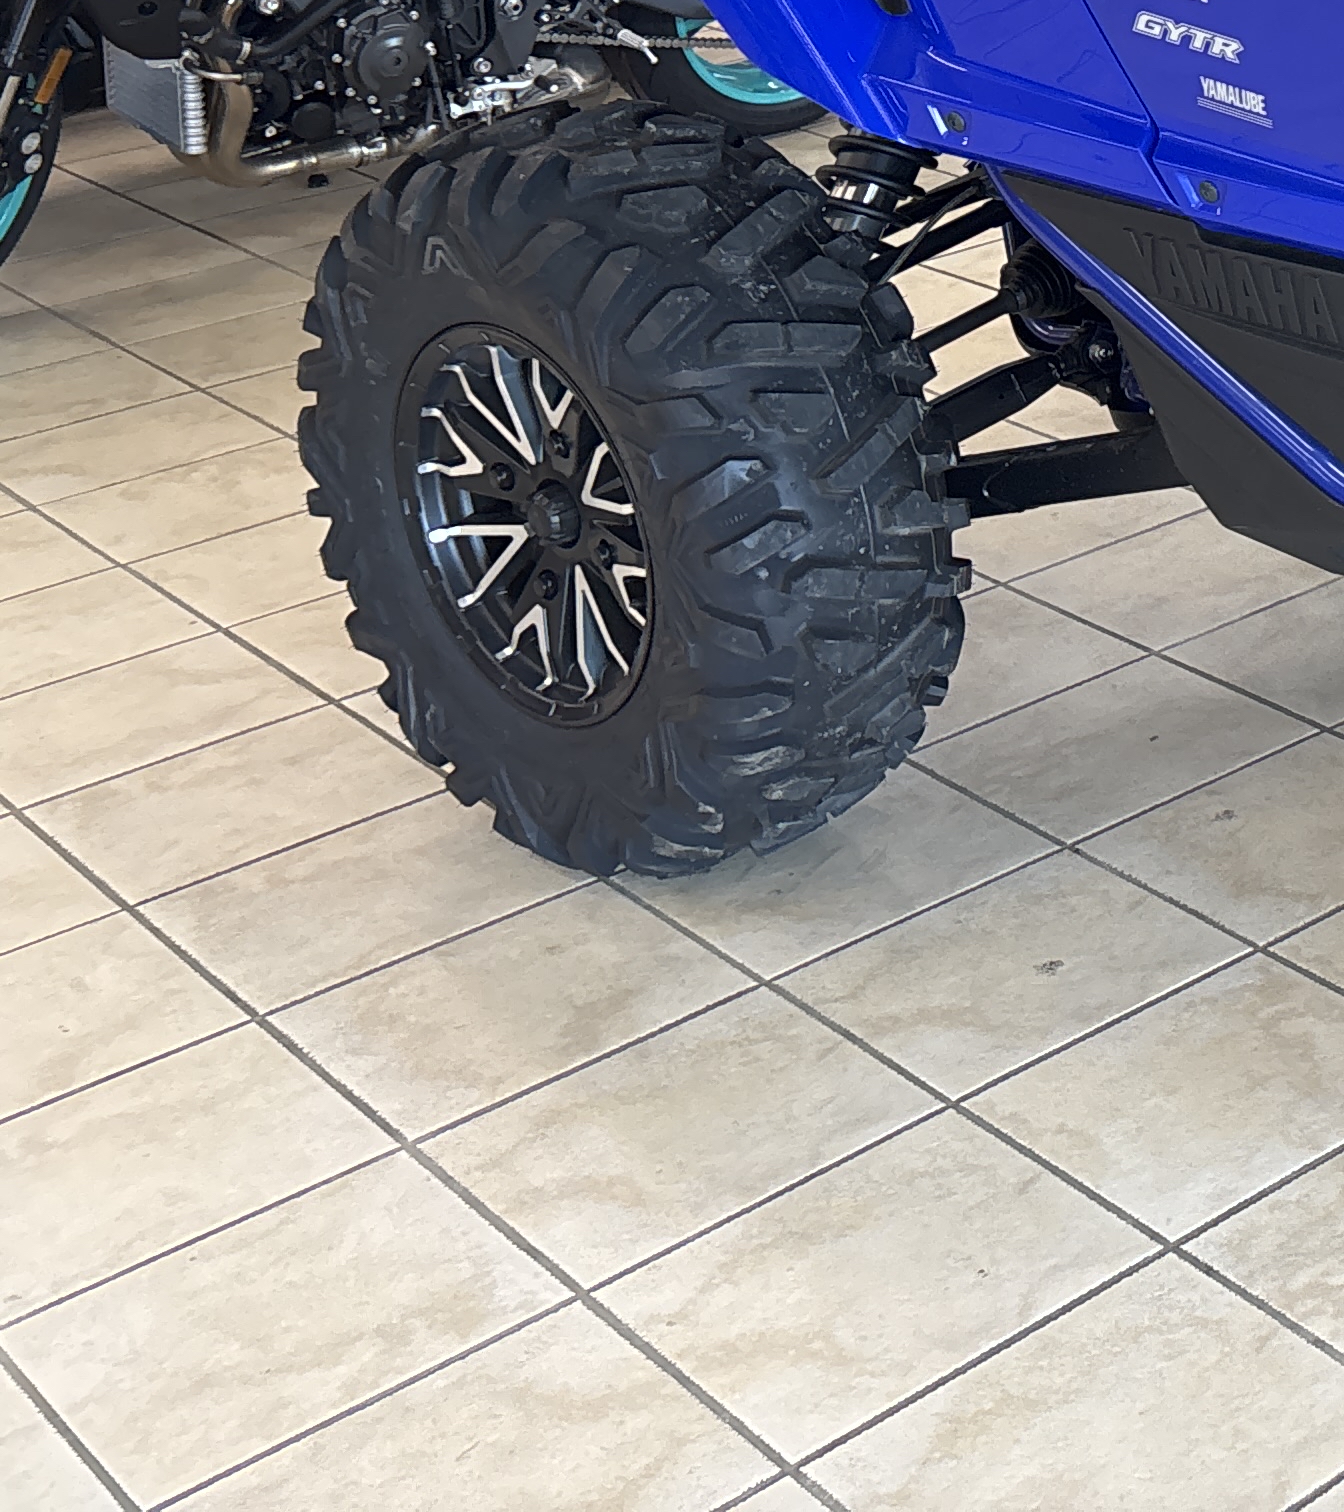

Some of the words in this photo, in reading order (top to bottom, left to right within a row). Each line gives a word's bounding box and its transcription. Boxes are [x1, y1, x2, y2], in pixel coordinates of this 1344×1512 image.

[1132, 10, 1245, 65] GYTR
[1199, 75, 1268, 116] YAMALUBE
[1122, 225, 1338, 345] YAMAHA
